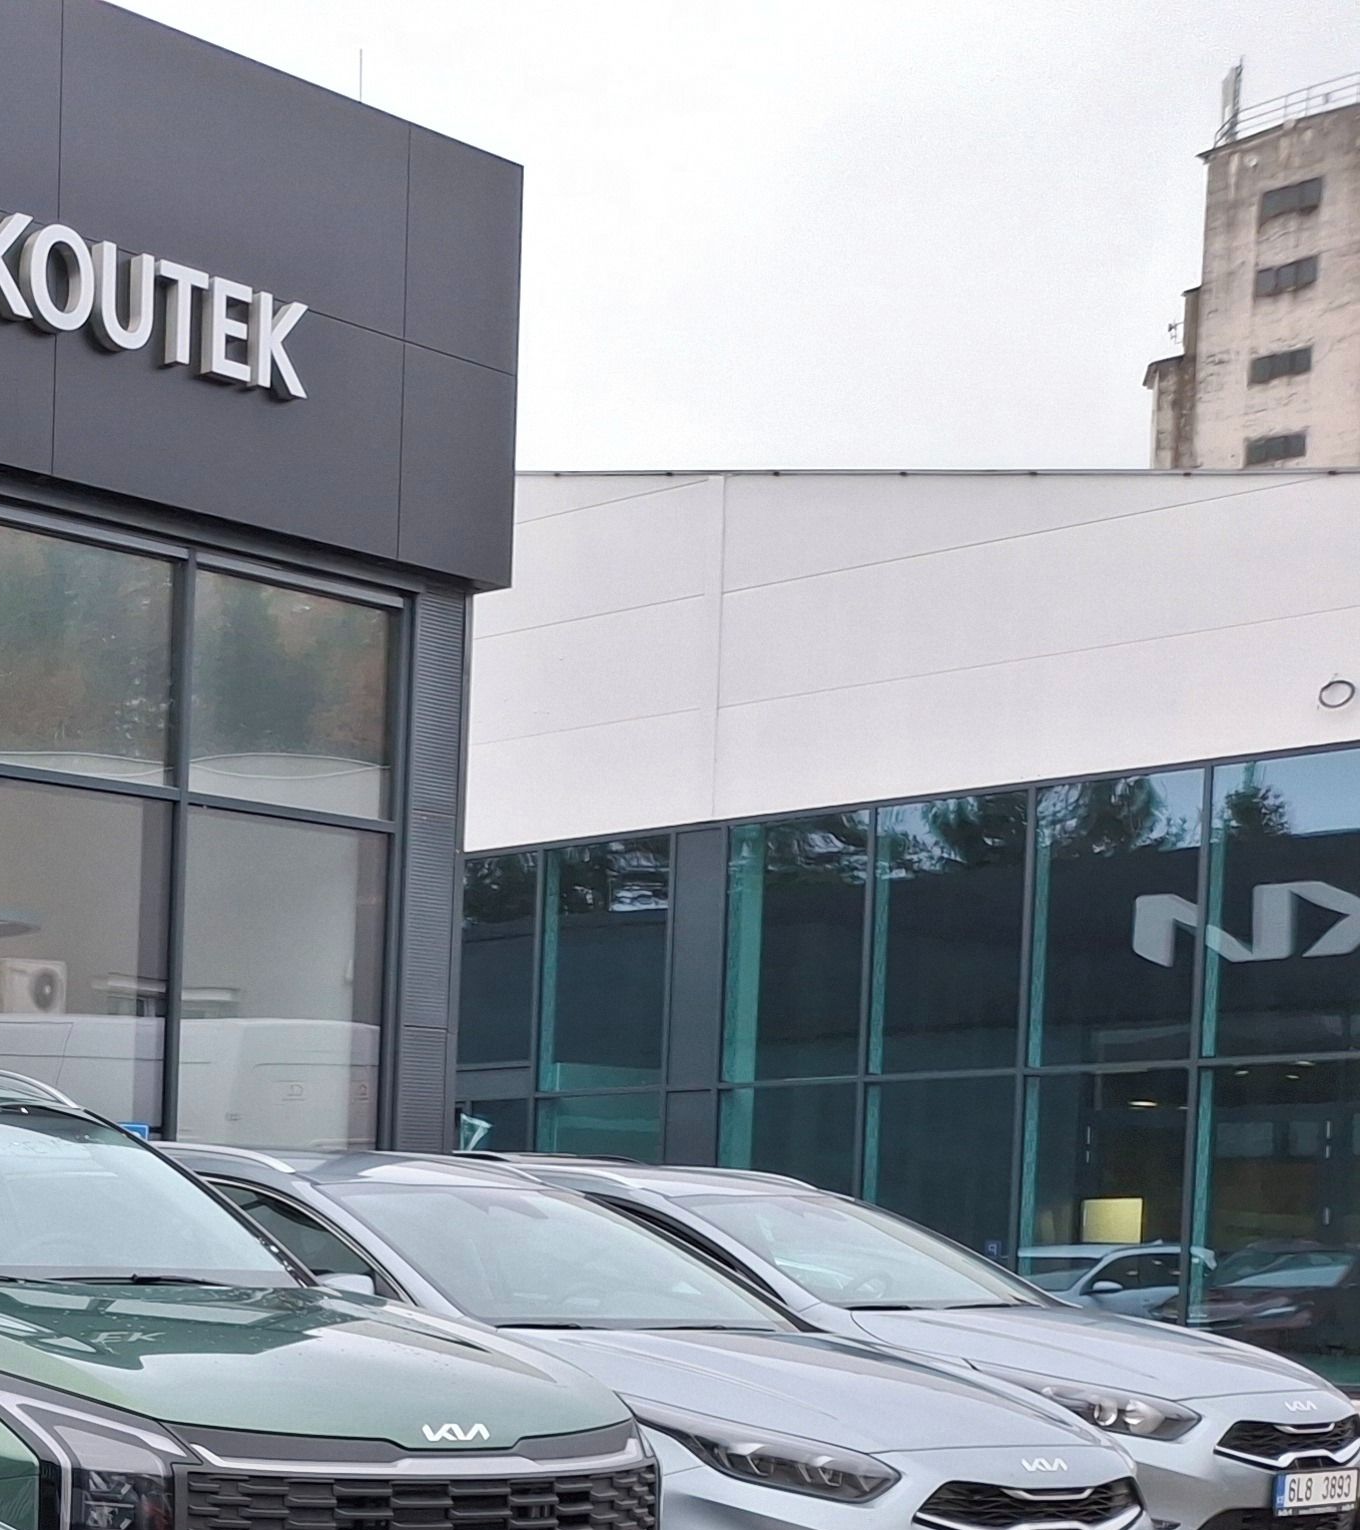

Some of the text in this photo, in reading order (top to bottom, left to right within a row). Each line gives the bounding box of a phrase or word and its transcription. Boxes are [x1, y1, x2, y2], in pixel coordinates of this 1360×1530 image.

[422, 1423, 491, 1442] KIA
[1021, 1457, 1068, 1472] KIA
[1288, 1474, 1352, 1503] 6L8 3893
